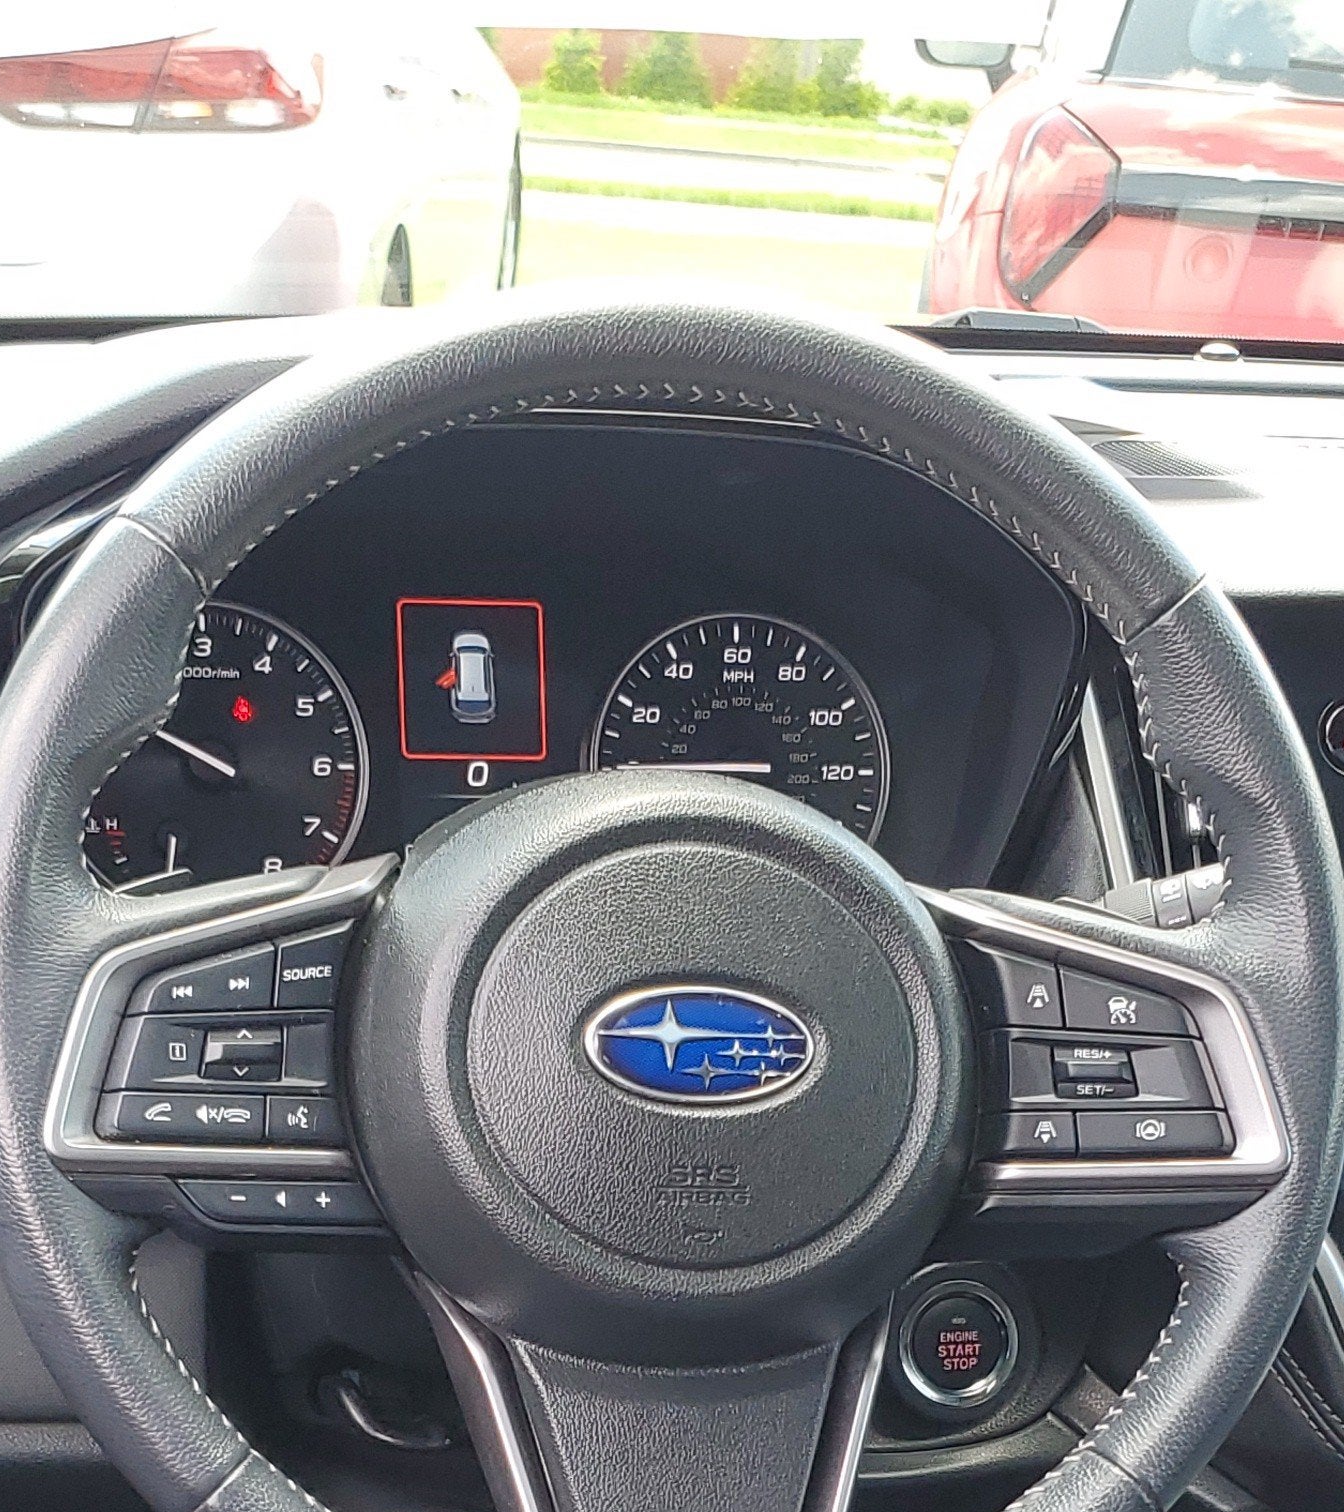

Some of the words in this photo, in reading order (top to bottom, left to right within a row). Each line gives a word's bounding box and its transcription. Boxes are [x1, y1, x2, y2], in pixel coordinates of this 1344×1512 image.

[194, 638, 212, 657] 3
[724, 649, 751, 664] 60
[254, 656, 272, 674] 4
[664, 664, 693, 679] 40
[183, 667, 240, 679] 000r/min
[723, 671, 754, 683] MPH
[778, 666, 805, 681] 80
[296, 697, 315, 717] 5
[732, 697, 752, 707] 100
[632, 708, 660, 723] 20
[809, 711, 843, 726] 100
[679, 724, 696, 734] 40
[671, 744, 688, 754] 20
[312, 756, 332, 776] 6
[821, 765, 854, 780] 120
[467, 761, 488, 787] 0
[106, 819, 118, 830] H
[303, 816, 321, 836] 7
[282, 965, 333, 982] SOURCE
[940, 1331, 979, 1343] ENGINE
[938, 1343, 982, 1358] START
[943, 1358, 978, 1371] STOP
